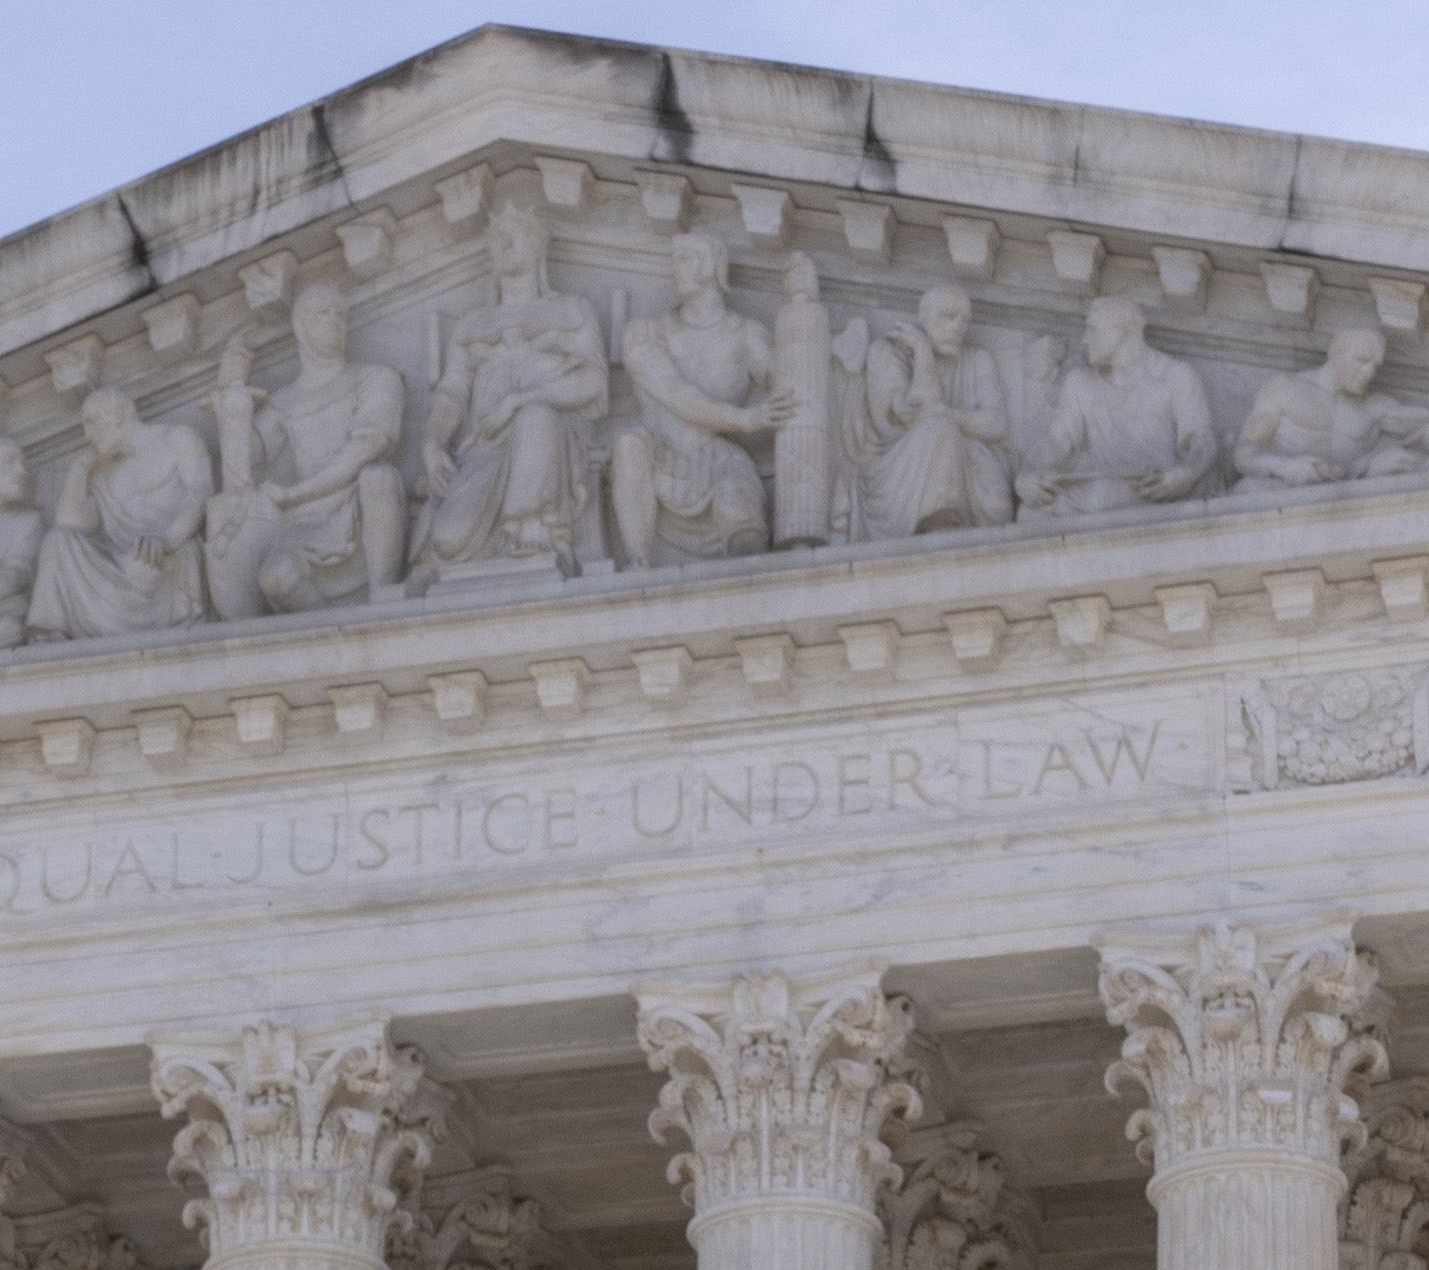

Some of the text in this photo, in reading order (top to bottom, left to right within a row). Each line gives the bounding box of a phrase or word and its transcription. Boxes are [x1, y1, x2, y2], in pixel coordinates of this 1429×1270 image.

[225, 788, 580, 884] JUSTICE
[630, 746, 945, 840] UNDER
[981, 718, 1164, 801] LAW
